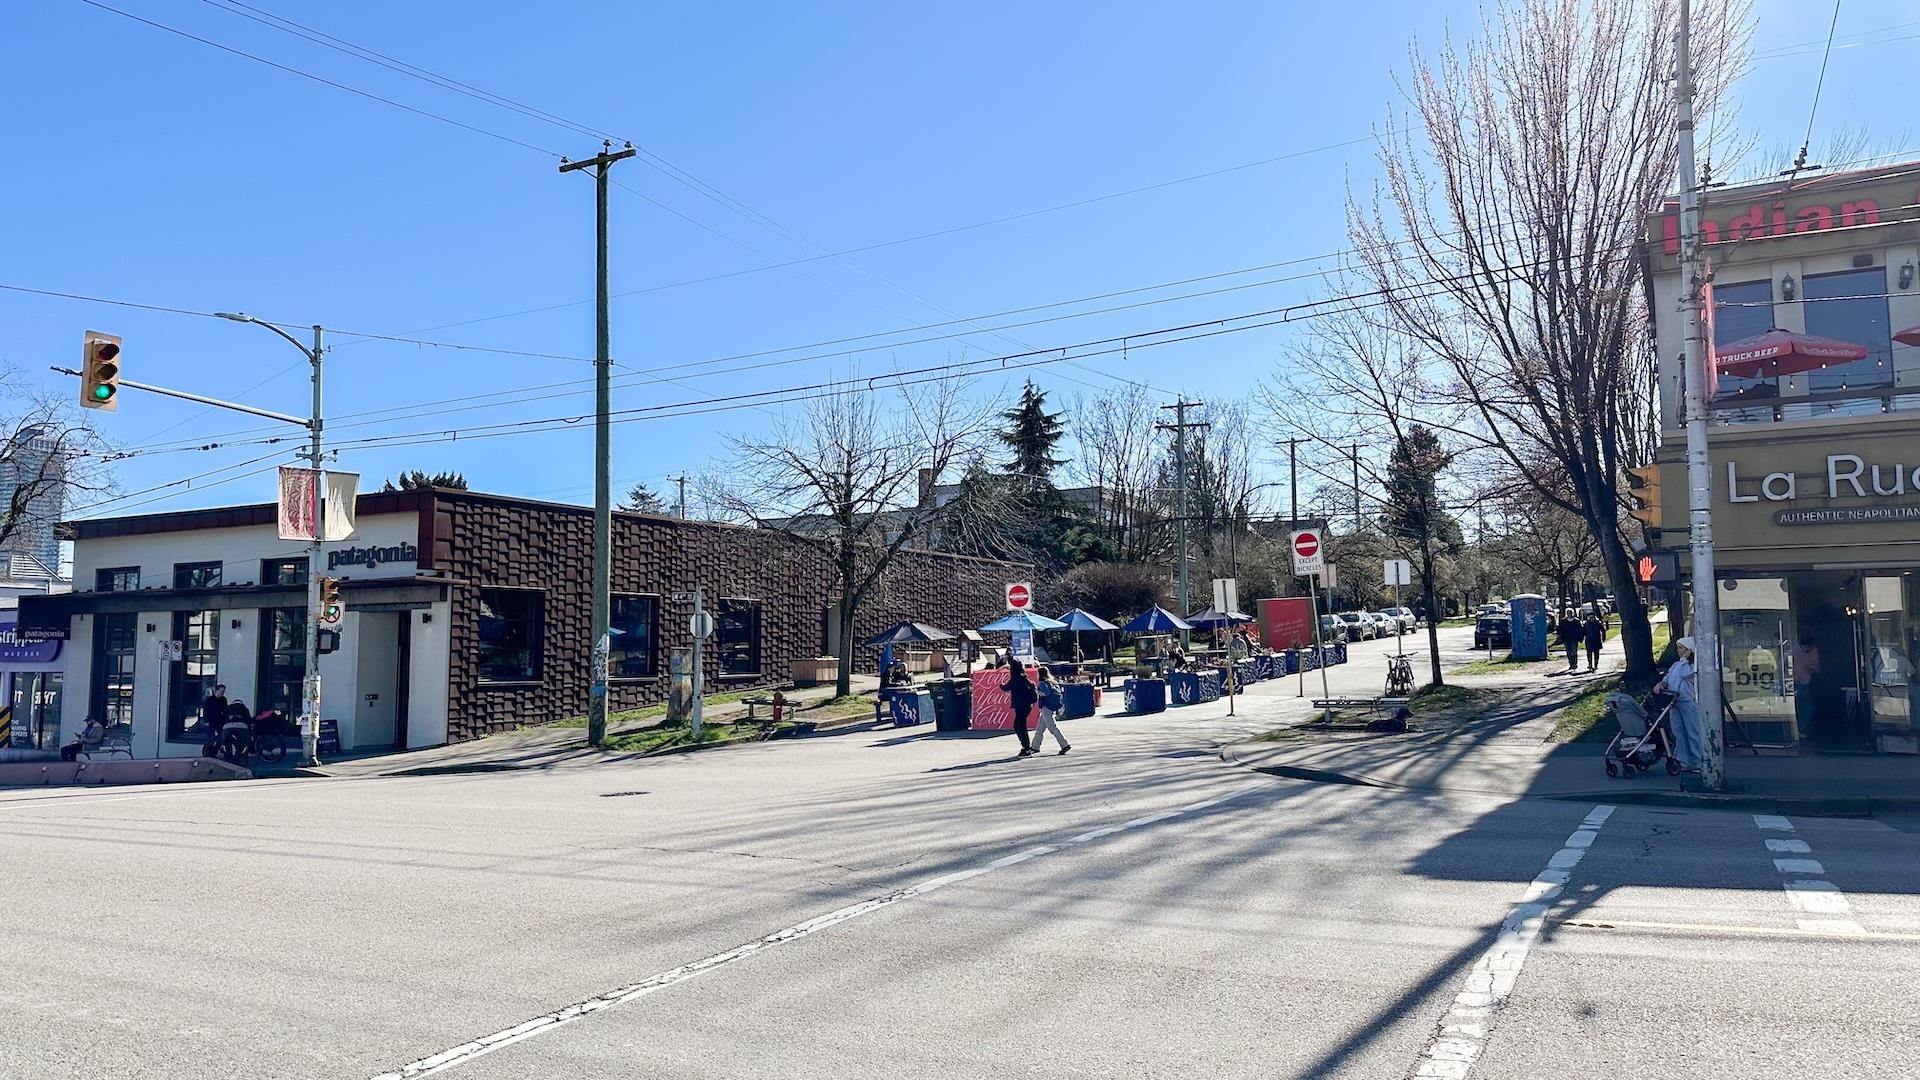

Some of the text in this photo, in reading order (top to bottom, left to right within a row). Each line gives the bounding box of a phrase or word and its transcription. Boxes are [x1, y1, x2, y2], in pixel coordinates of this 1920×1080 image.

[1721, 351, 1753, 363] TRUCK
[1754, 346, 1779, 358] BEER
[1727, 461, 1797, 503] La
[1779, 509, 1846, 524] AUTHENTIC
[327, 541, 418, 571] patagonia
[24, 630, 65, 638] patagonia
[975, 670, 1011, 690] Love
[975, 687, 1010, 711] Your
[974, 704, 1010, 730] City
